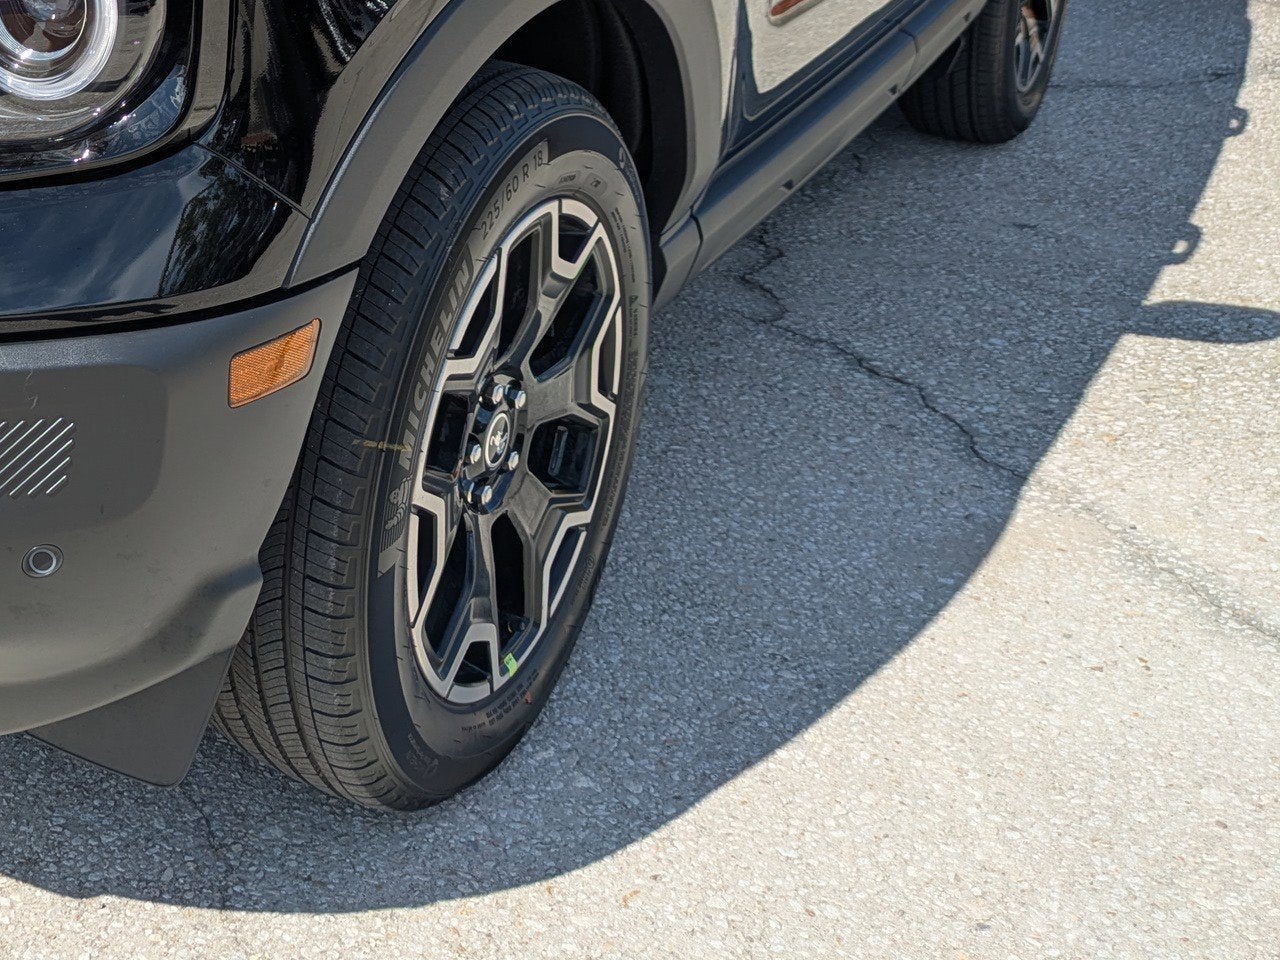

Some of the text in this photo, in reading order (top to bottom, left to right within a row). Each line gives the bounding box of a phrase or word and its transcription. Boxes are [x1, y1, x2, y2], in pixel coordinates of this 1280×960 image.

[480, 150, 544, 240] 225/60 R 18
[399, 258, 469, 471] MICHELIN
